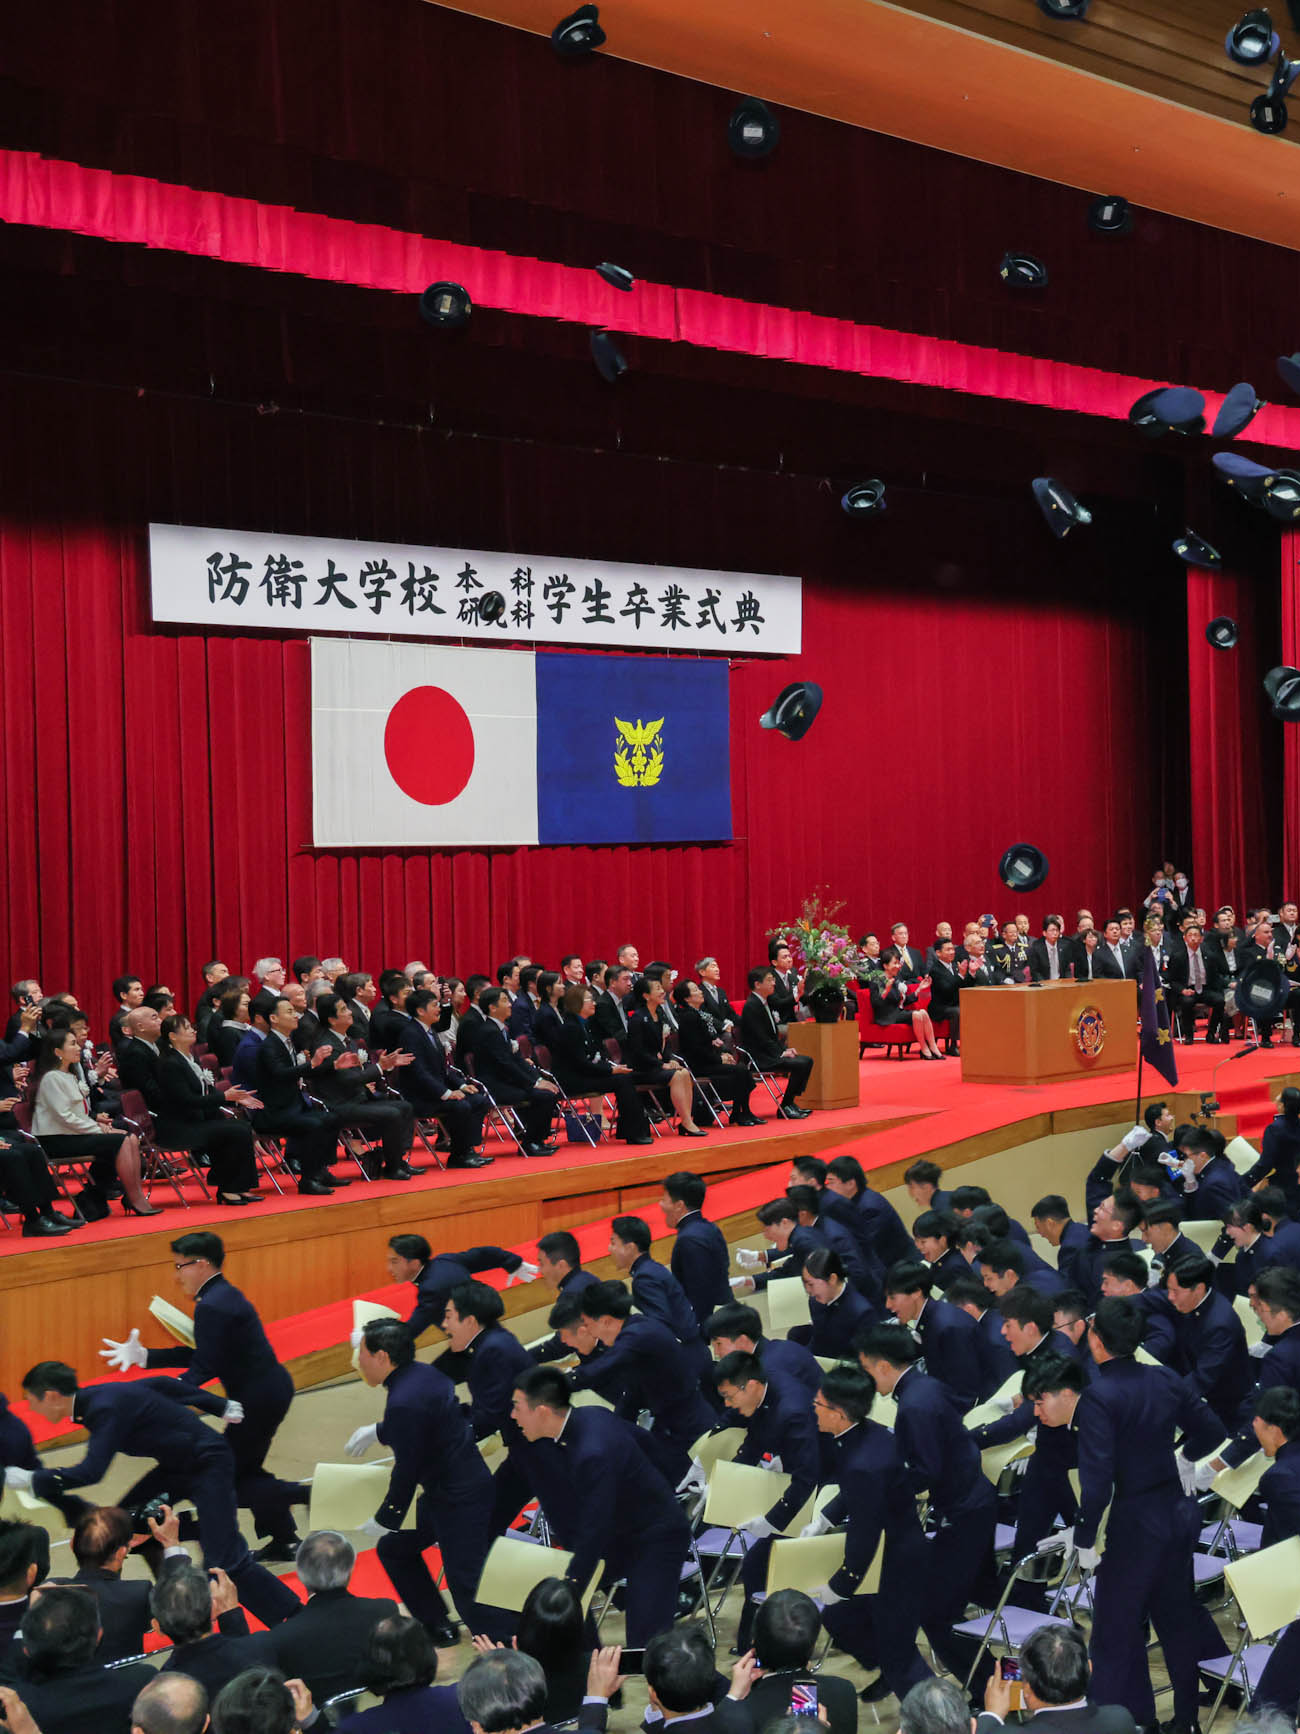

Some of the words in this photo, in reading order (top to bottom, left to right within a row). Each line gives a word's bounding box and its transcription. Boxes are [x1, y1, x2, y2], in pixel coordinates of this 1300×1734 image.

[206, 551, 447, 616] 防衛大学校
[454, 561, 536, 598] 本科
[543, 573, 766, 635] 学生卒業式典
[456, 596, 536, 630] 研科
